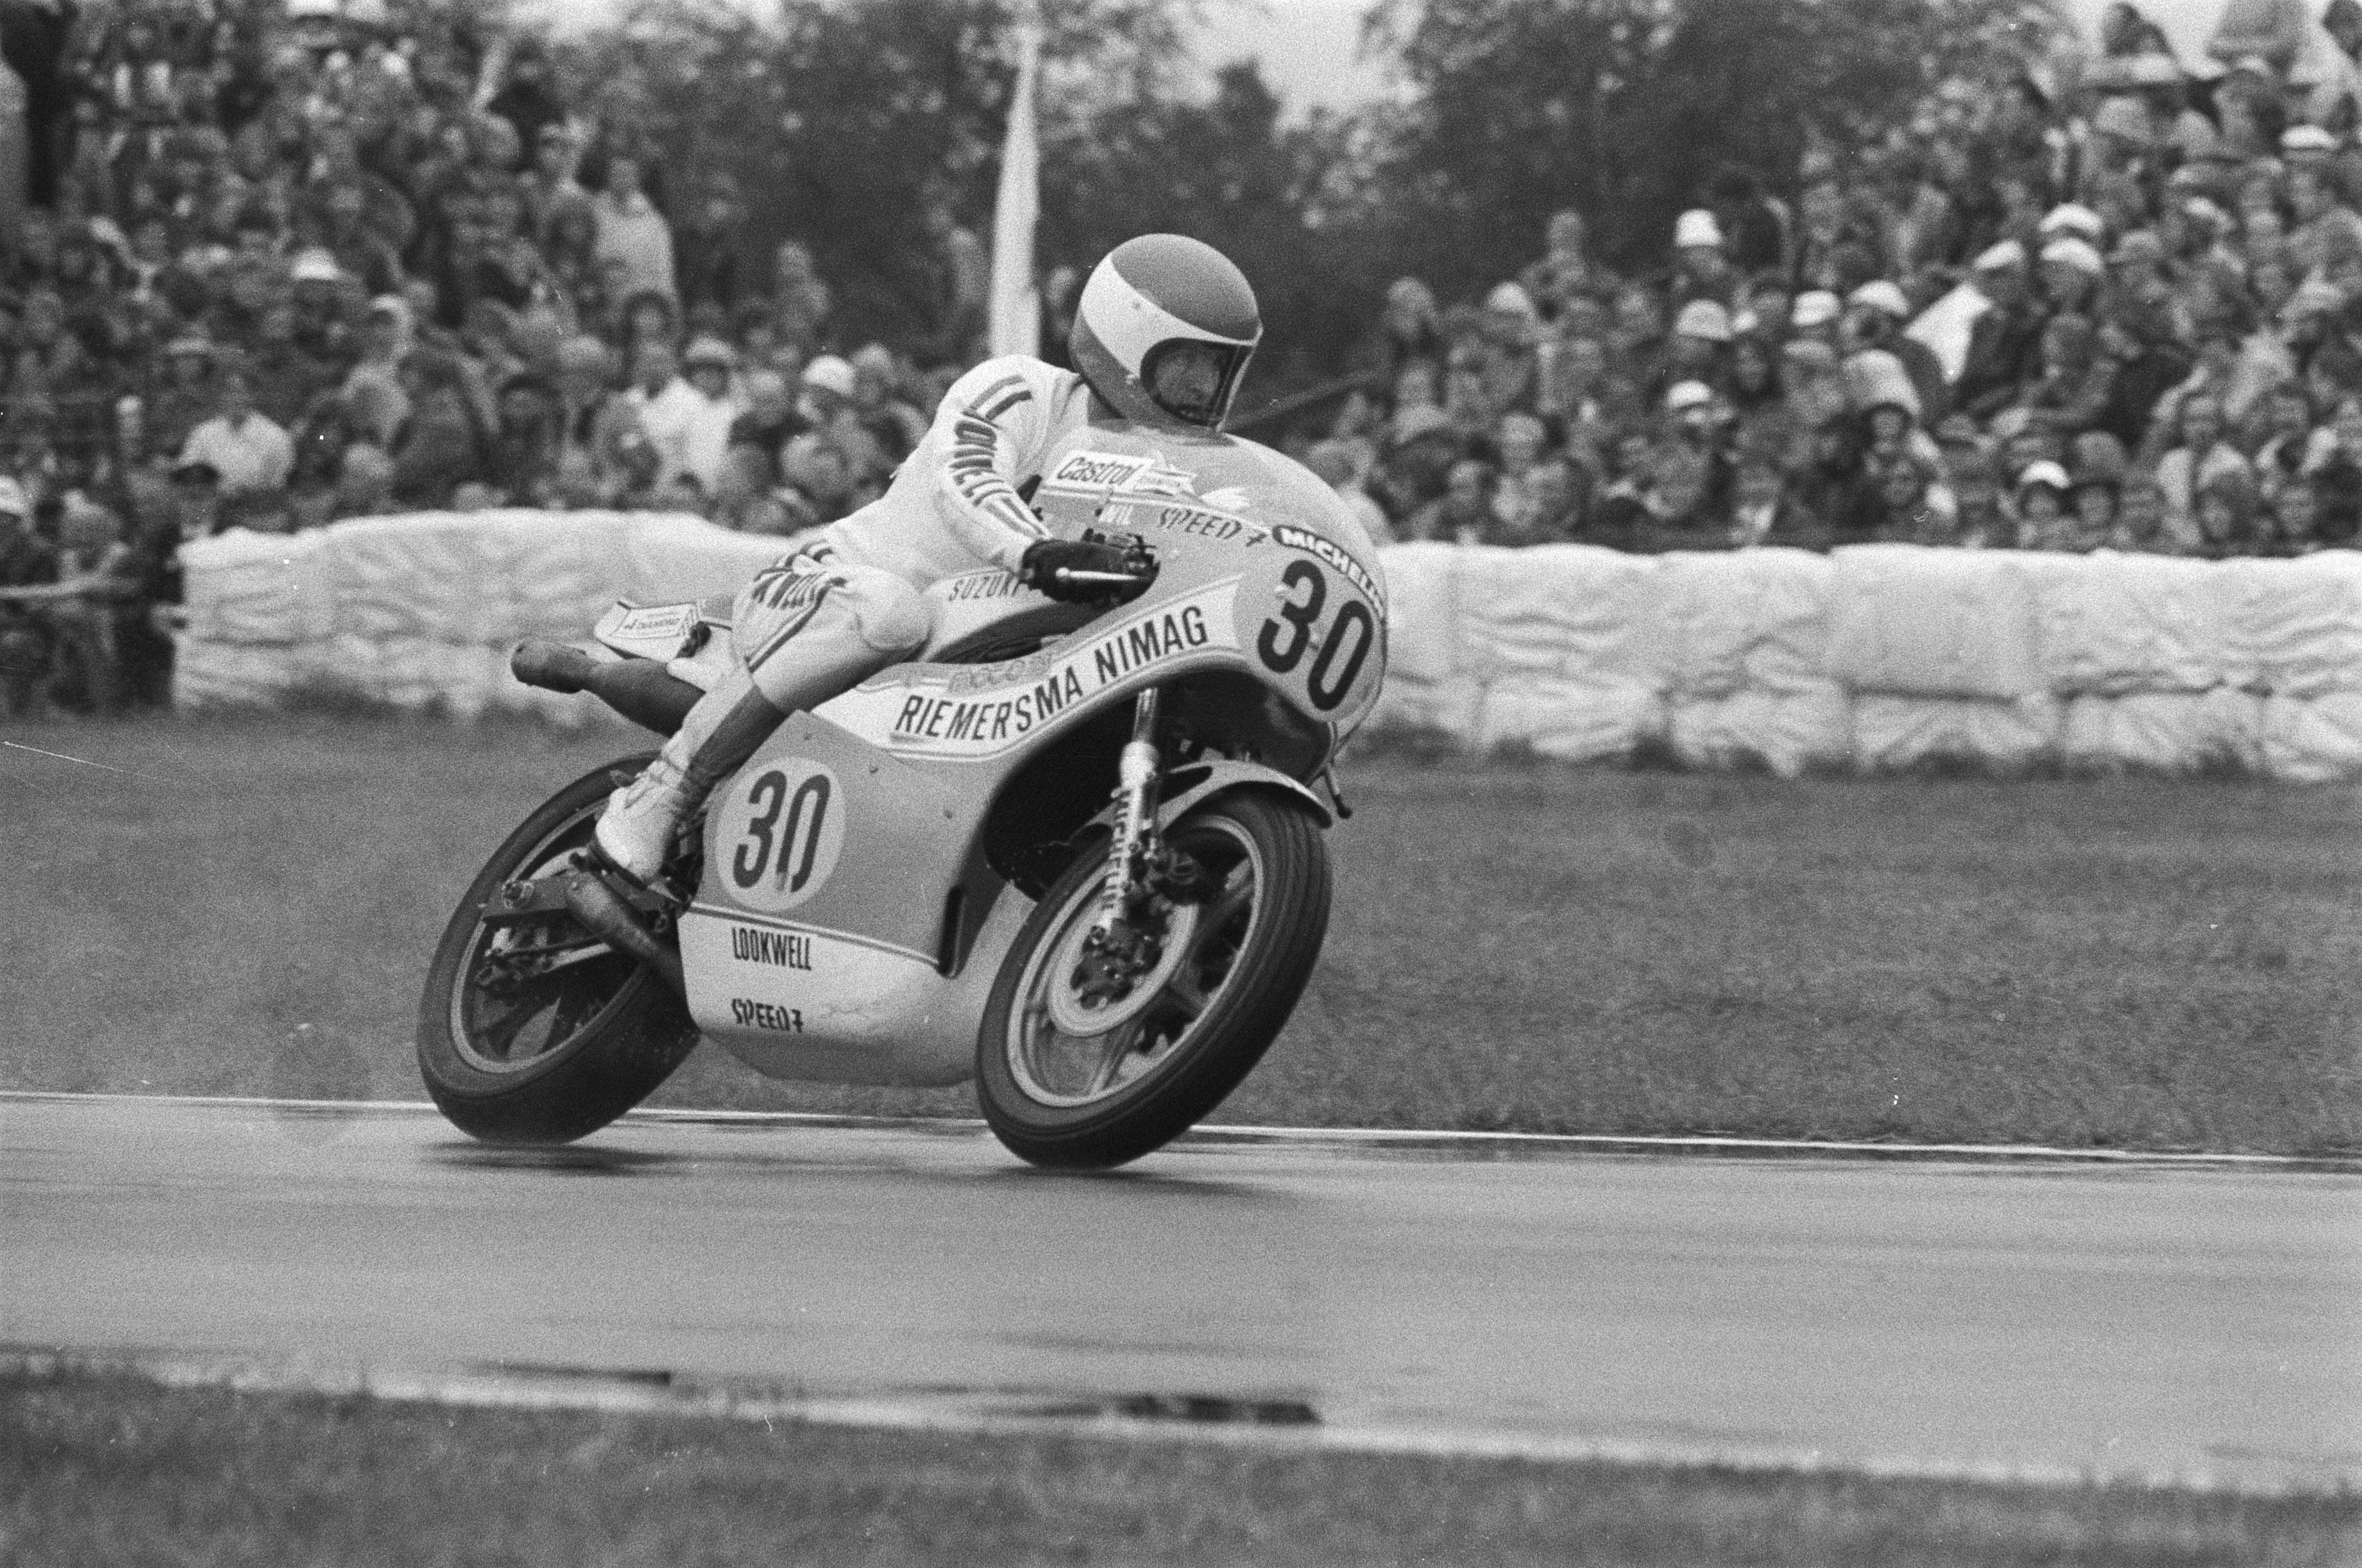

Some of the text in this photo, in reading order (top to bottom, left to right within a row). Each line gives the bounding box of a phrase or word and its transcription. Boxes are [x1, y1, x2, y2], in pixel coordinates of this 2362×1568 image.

[1057, 457, 1144, 485] Castrol
[1158, 507, 1242, 539] SPEED
[947, 572, 1020, 602] SUZUKI
[1257, 559, 1373, 711] 30
[896, 665, 1083, 741] RIEMERSMA
[1094, 605, 1208, 684] NIMAG
[733, 770, 831, 893] 30
[731, 927, 812, 972] LOOKWELL
